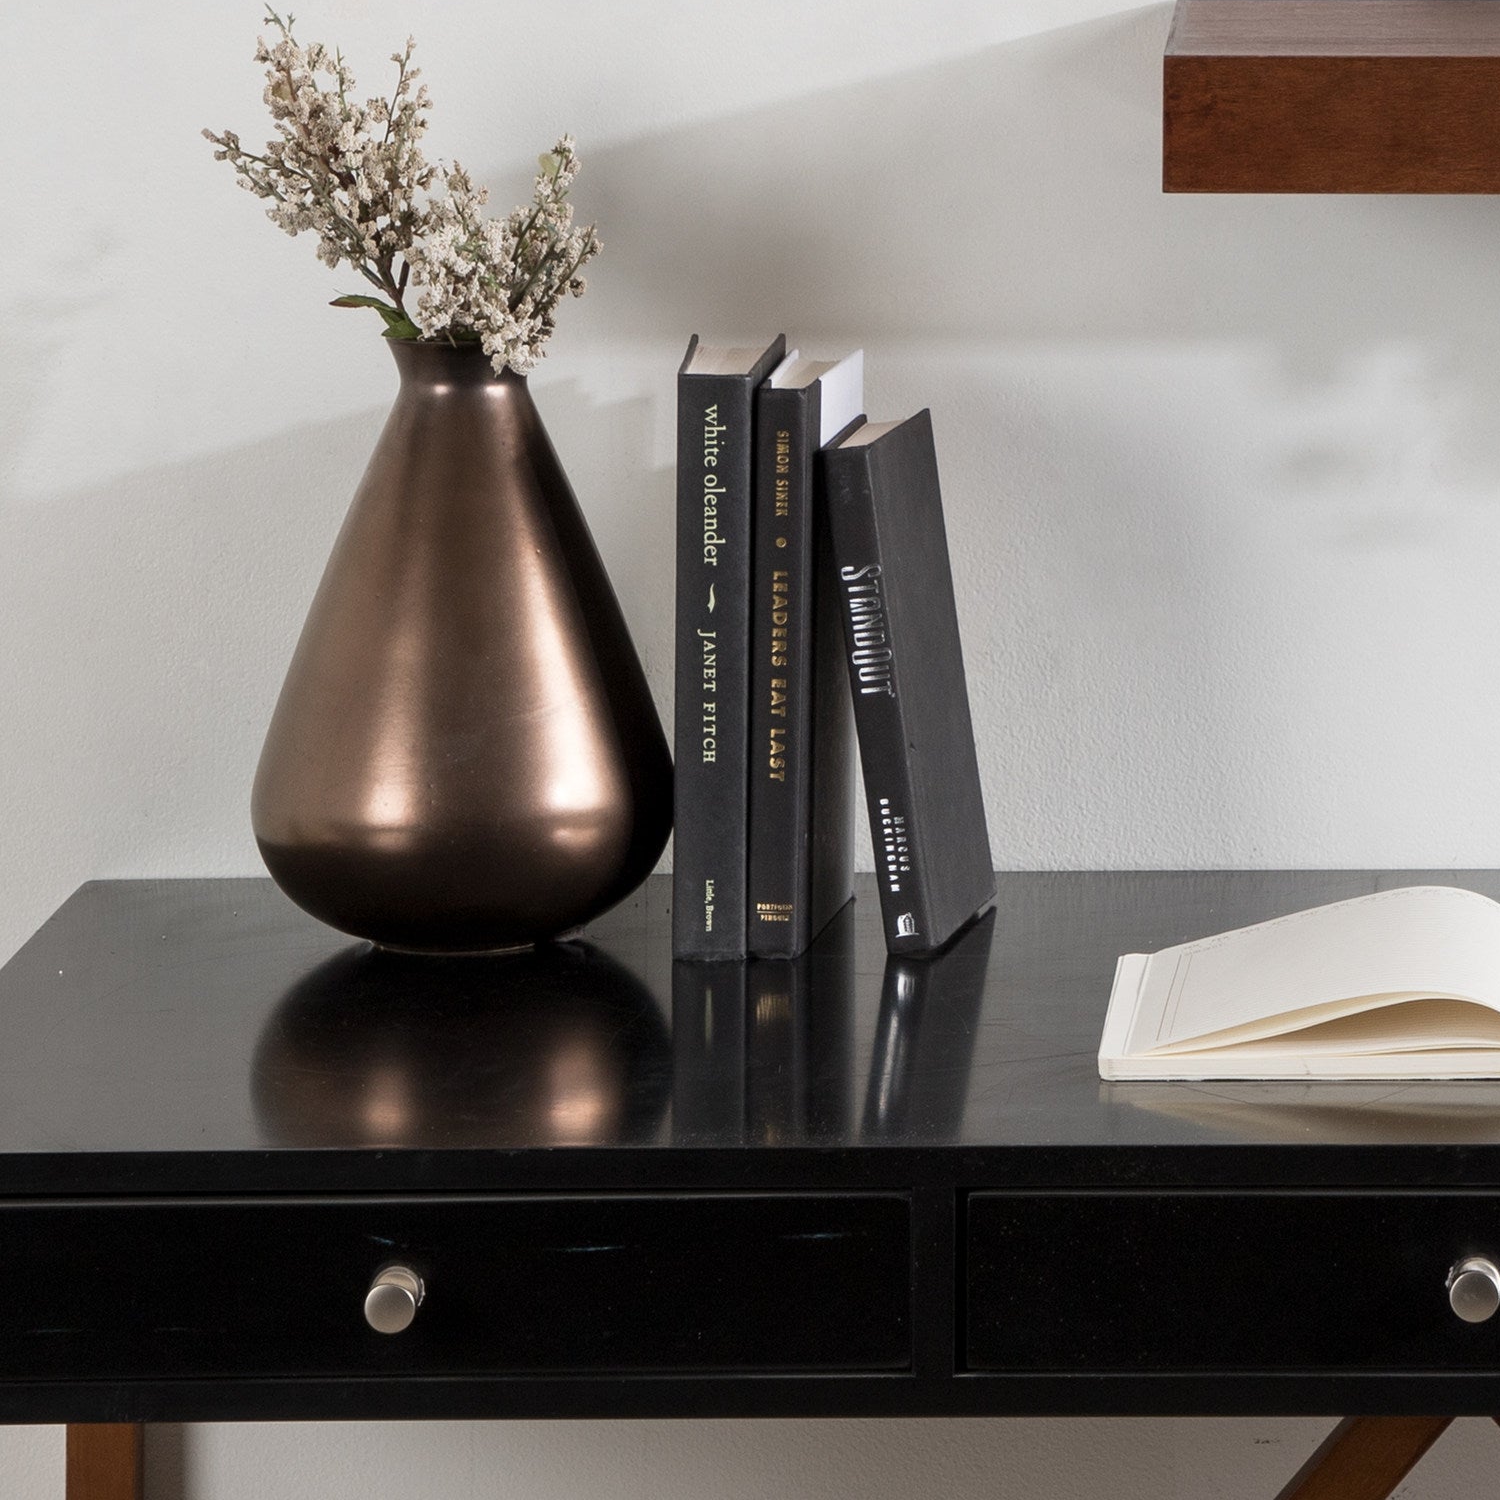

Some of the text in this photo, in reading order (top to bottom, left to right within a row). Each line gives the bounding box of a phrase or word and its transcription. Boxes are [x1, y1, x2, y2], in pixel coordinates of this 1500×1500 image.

[703, 403, 726, 566] white oleander
[774, 430, 789, 517] SIMON SINEK
[769, 570, 788, 783] LEADERS EAT LAST
[840, 564, 892, 696] STANDOUT
[697, 628, 716, 763] JANET FITCH
[879, 798, 900, 892] BUCKINGHAM
[893, 816, 910, 872] MARCUS
[705, 904, 714, 932] Brown
